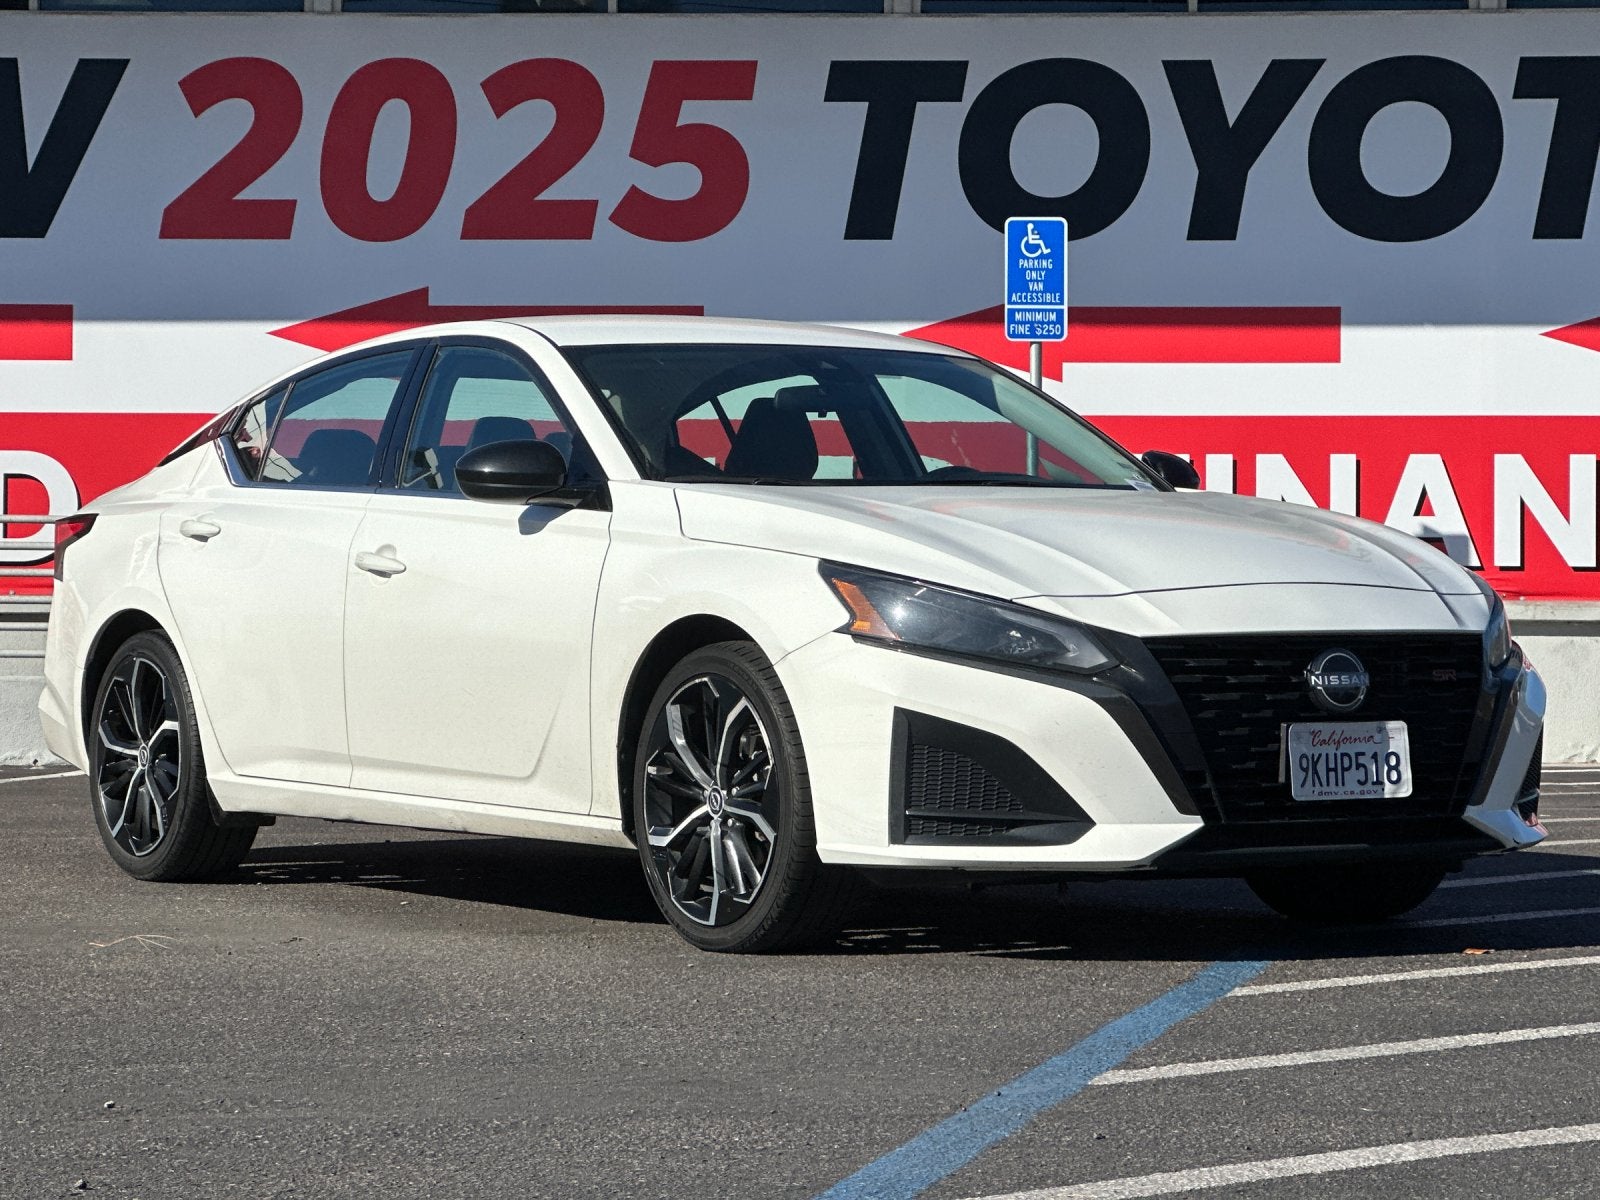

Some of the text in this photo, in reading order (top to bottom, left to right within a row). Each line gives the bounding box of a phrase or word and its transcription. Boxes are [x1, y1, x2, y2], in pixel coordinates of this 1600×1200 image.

[159, 56, 759, 242] 2025
[823, 55, 1600, 242] TOYOT
[1018, 259, 1053, 269] PARKING
[1025, 270, 1046, 280] ONLY
[1028, 282, 1044, 291] VAN
[1011, 293, 1060, 303] ACCESSIBLE
[1015, 311, 1056, 322] MINIMUM
[1010, 323, 1061, 336] FINE $250
[1311, 674, 1370, 686] NISSAN
[1432, 669, 1457, 681] SR
[1311, 730, 1382, 751] California
[1299, 751, 1402, 788] 9KHP518
[1317, 788, 1378, 797] dmv.ca.gov
